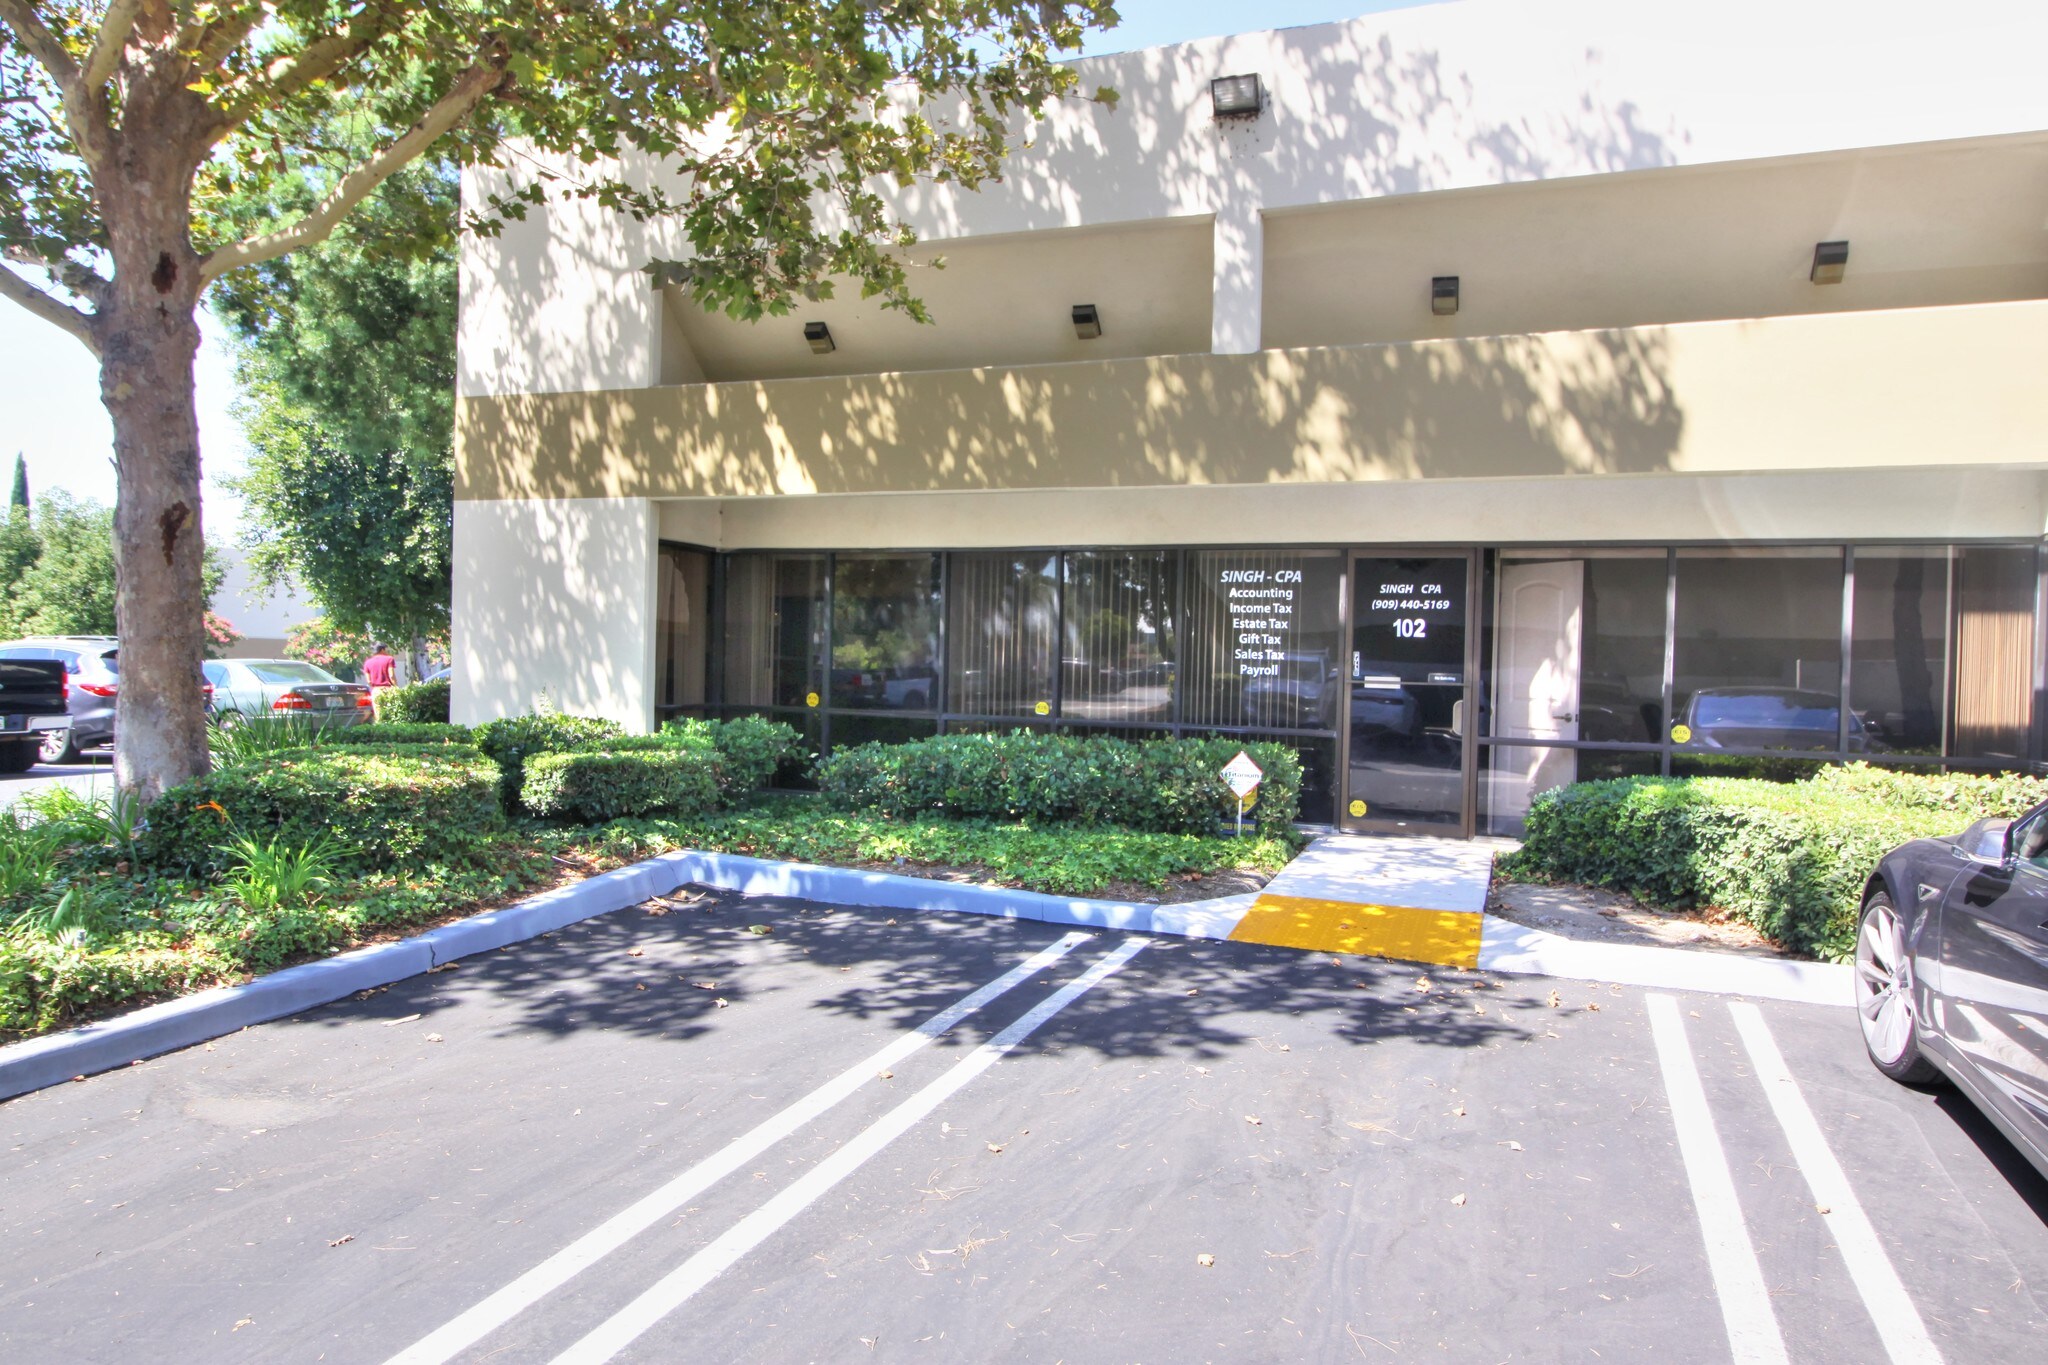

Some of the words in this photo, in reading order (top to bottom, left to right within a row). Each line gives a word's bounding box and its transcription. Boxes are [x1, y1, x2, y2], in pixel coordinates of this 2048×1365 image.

[1220, 570, 1265, 583] SINGH
[1275, 570, 1302, 583] CPA
[1229, 587, 1293, 600] Accounting
[1379, 584, 1414, 594] SINGH
[1421, 584, 1441, 594] CPA
[1229, 602, 1271, 614] Income
[1272, 603, 1293, 614] Tax
[1371, 600, 1398, 610] (909)
[1400, 600, 1450, 610] 440-5169
[1232, 618, 1267, 629] Estate
[1268, 618, 1289, 629] Tax
[1392, 618, 1426, 638] 102
[1239, 633, 1260, 644] Gift
[1261, 634, 1282, 645] Tax
[1234, 648, 1264, 660] Sales
[1265, 649, 1285, 660] Tax
[1240, 664, 1279, 678] Payroll
